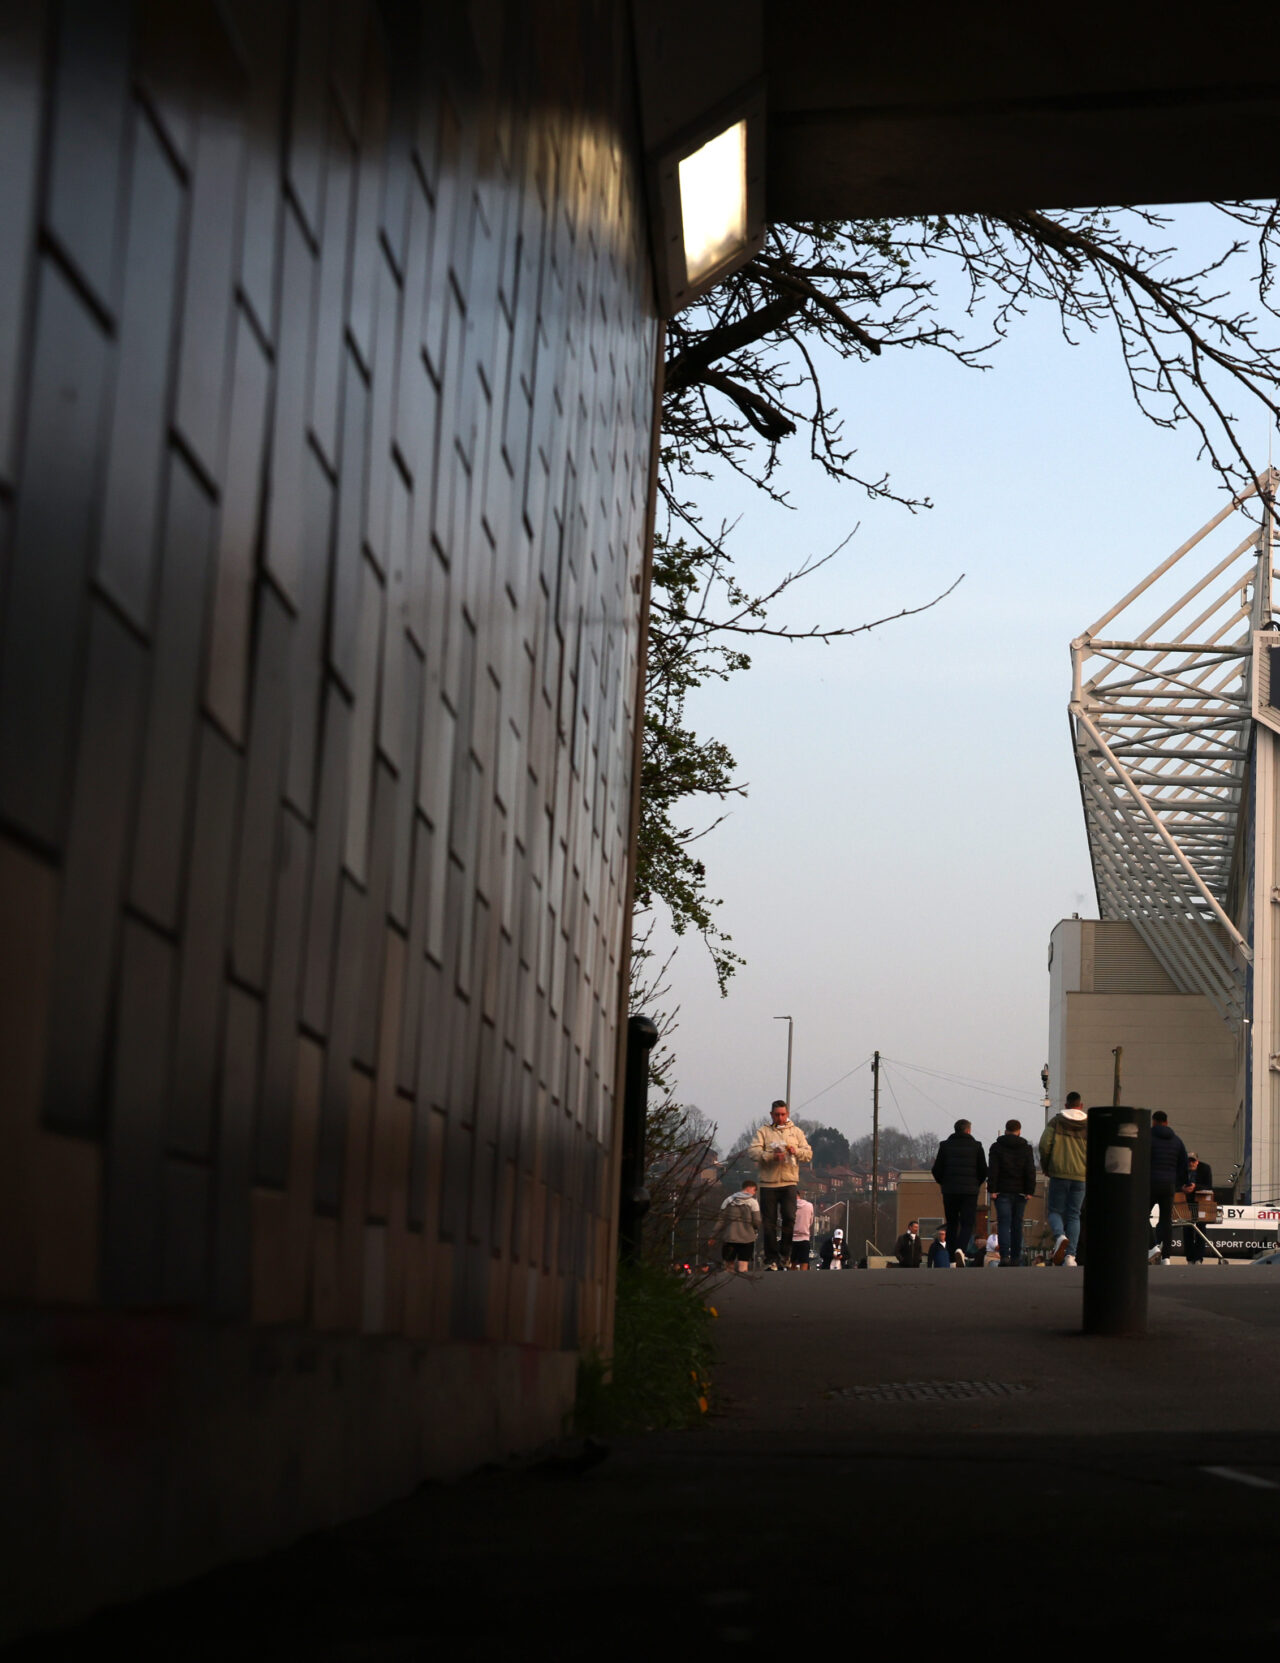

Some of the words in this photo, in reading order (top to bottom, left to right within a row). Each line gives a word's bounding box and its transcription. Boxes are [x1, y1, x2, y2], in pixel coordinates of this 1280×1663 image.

[1227, 1208, 1245, 1218] BY
[1215, 1240, 1243, 1248] SPORT
[1245, 1241, 1278, 1249] COLLEG
